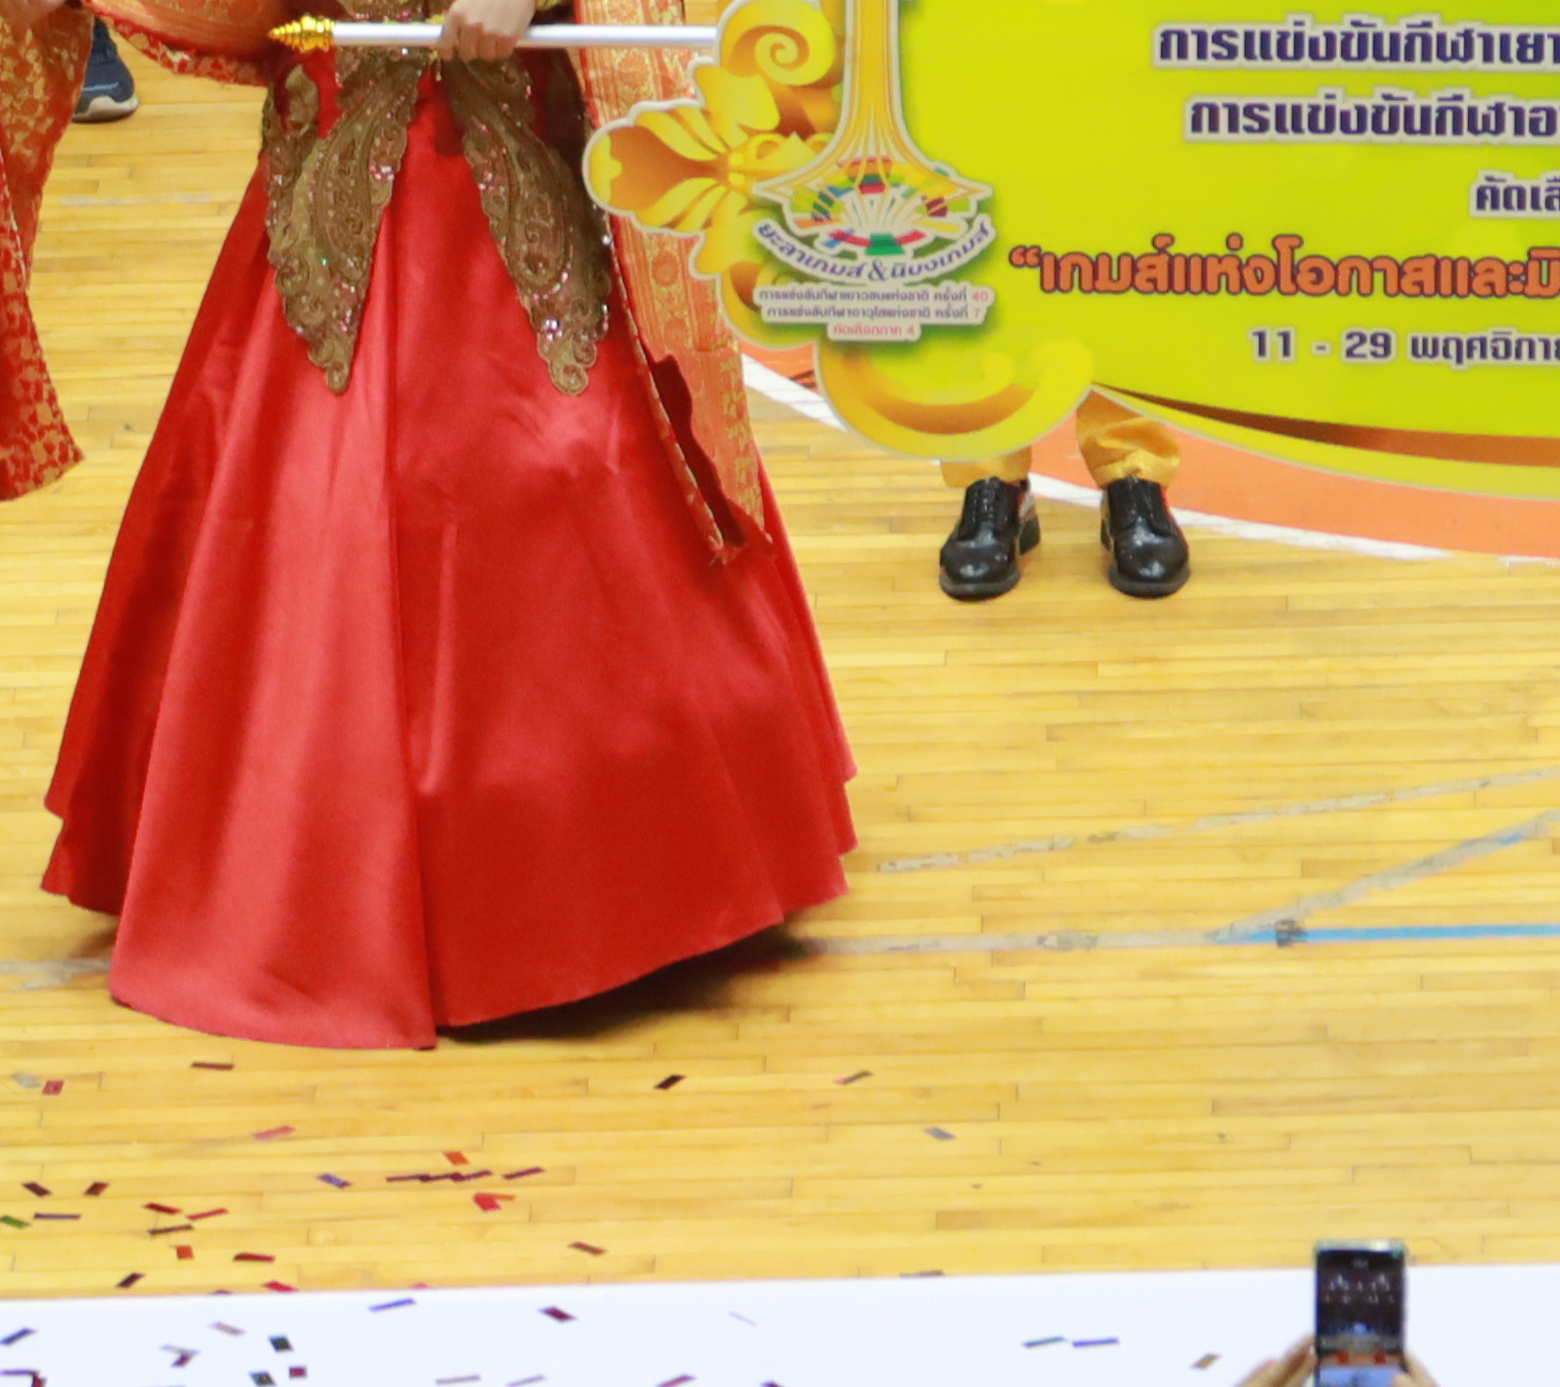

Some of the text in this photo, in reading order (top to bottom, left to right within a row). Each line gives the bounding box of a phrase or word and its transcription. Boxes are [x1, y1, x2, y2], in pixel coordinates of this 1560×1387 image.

[971, 290, 990, 303] 40
[1253, 330, 1291, 358] 11
[1345, 331, 1391, 359] 29
